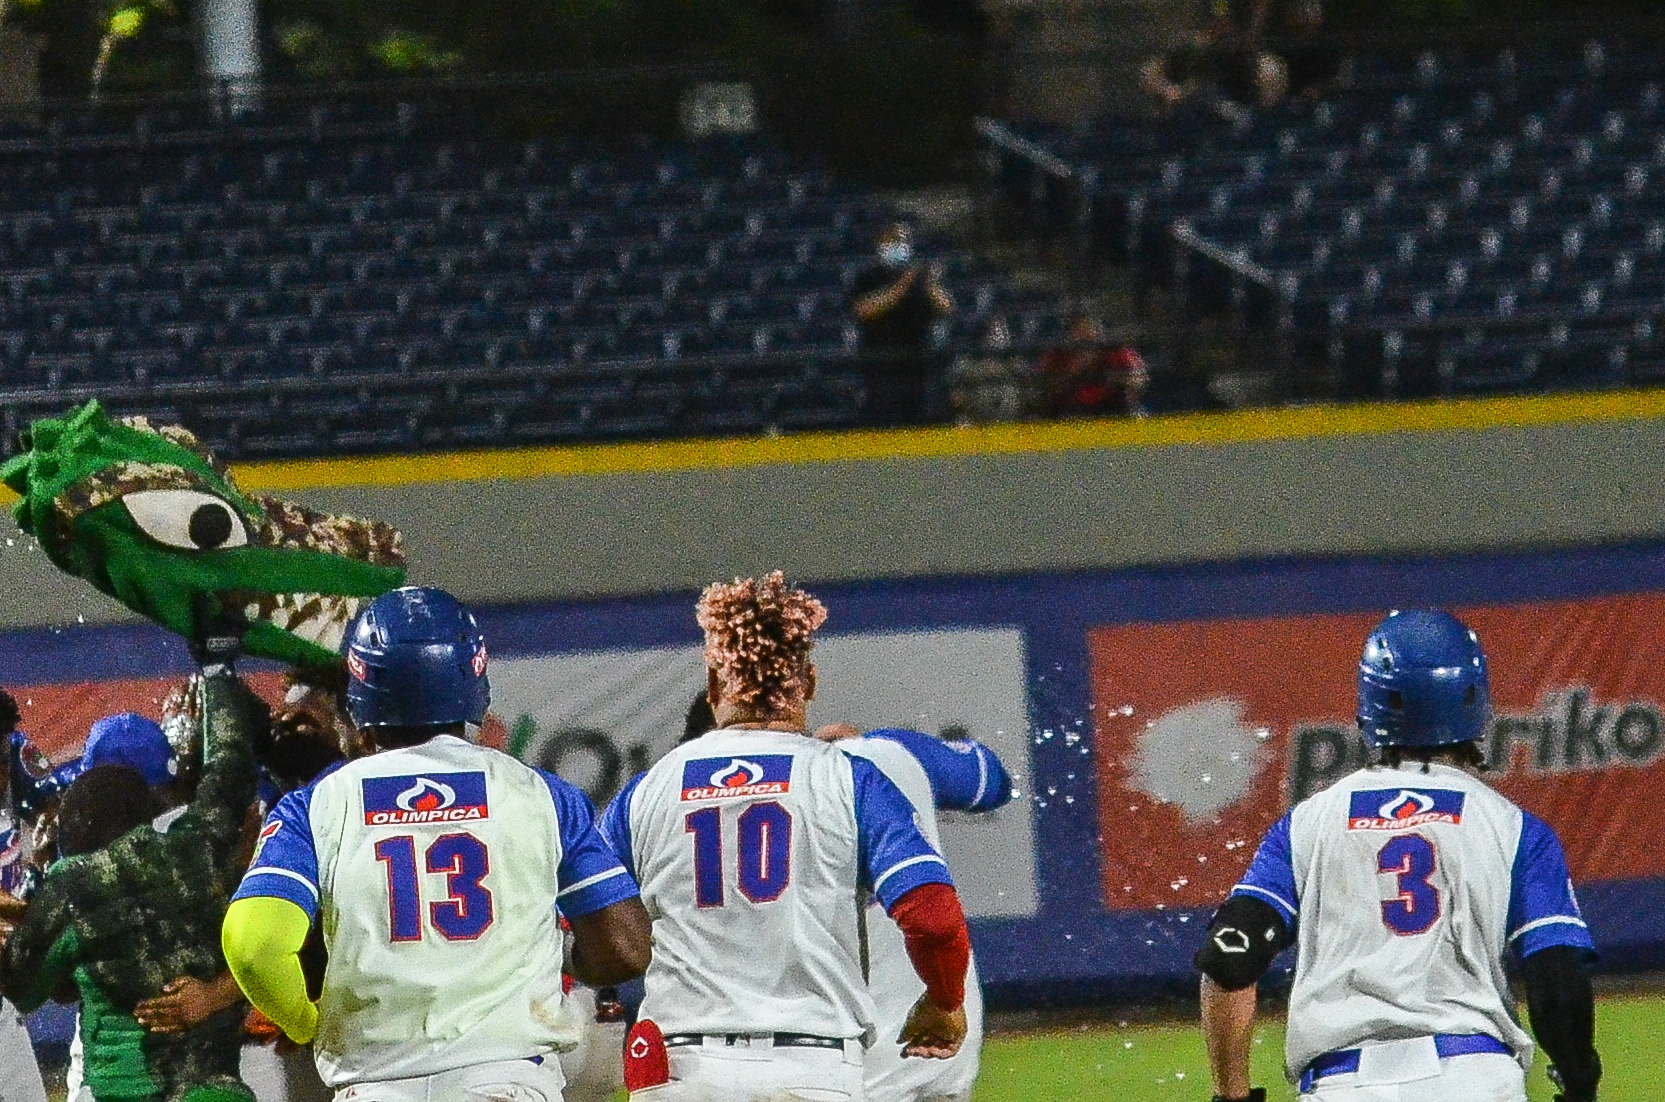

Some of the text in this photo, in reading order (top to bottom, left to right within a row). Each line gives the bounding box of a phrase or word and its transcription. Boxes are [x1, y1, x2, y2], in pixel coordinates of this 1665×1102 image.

[372, 807, 482, 825] OLIMPICA
[686, 783, 783, 800] OLIMPICA
[1353, 812, 1454, 830] OLIMPICA
[684, 800, 793, 909] 10
[1377, 832, 1442, 937] 3
[373, 831, 494, 943] 13
